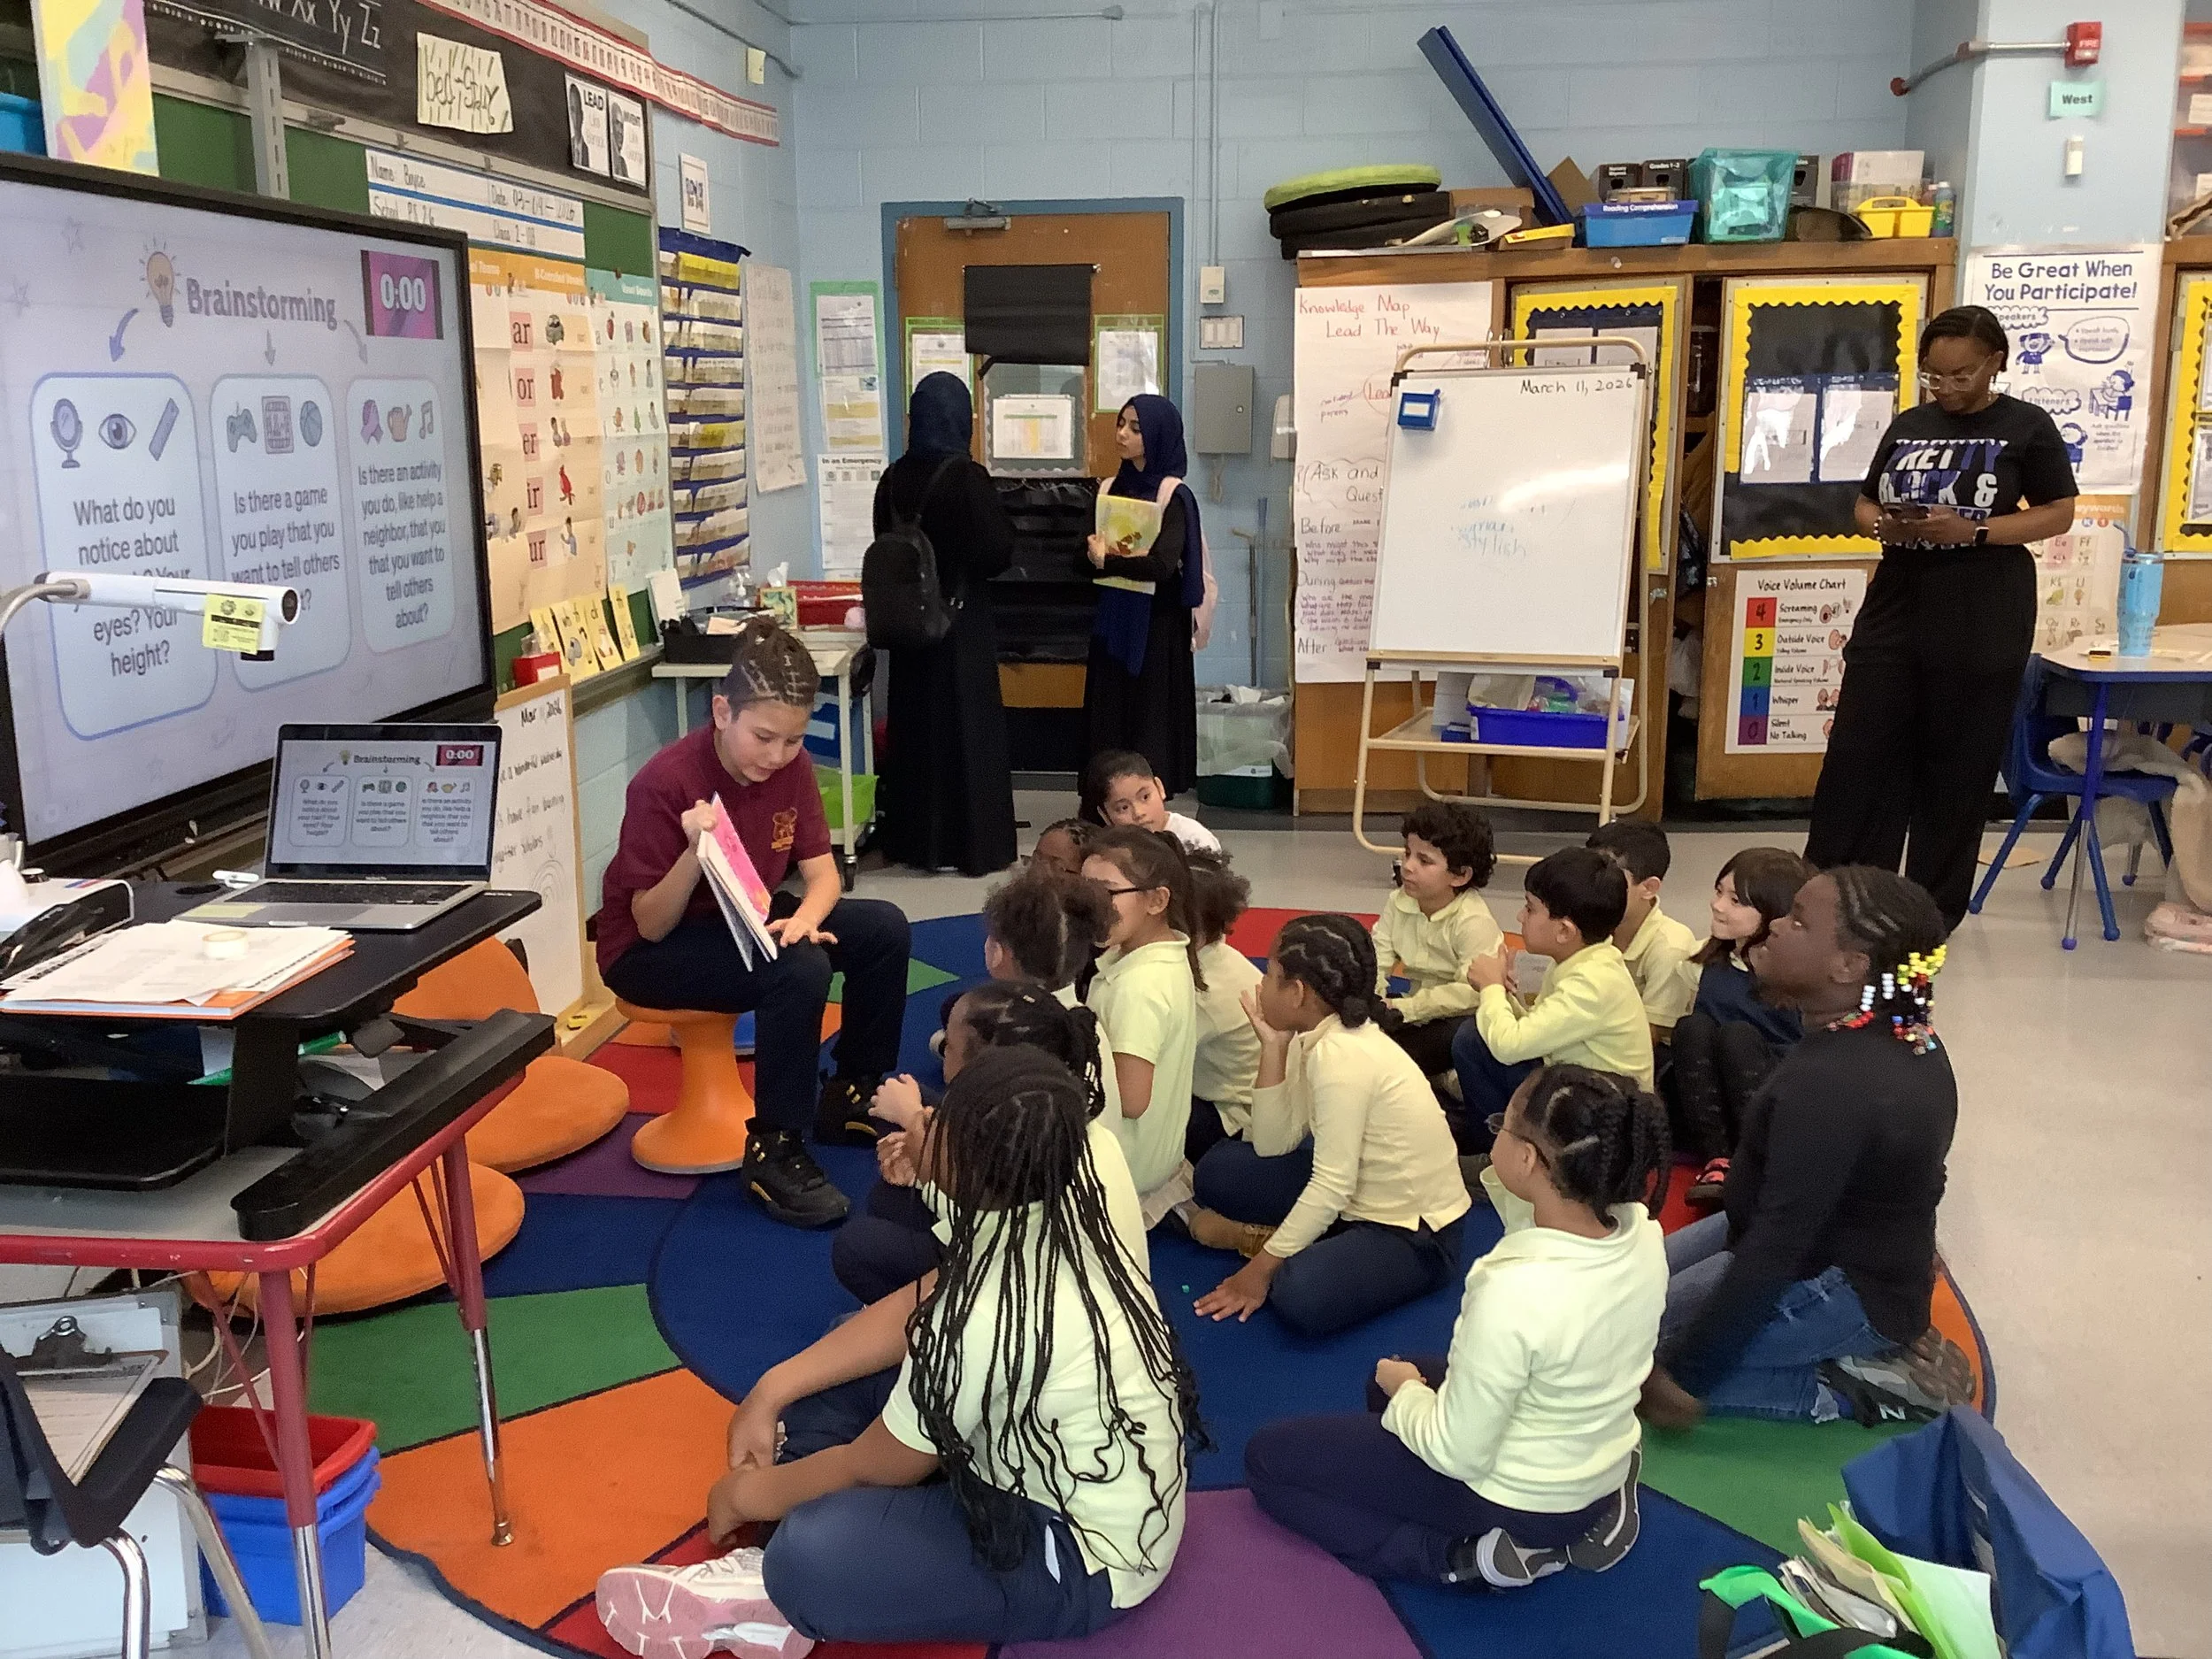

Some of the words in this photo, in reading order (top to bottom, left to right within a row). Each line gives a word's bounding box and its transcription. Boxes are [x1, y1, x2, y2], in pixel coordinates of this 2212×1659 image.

[583, 88, 603, 111] LEAD
[2062, 94, 2093, 104] West
[1991, 262, 2013, 280] Be
[2018, 260, 2079, 279] Great
[2085, 260, 2133, 277] When
[380, 273, 426, 312] 0:00
[1985, 283, 2015, 302] You
[2020, 281, 2138, 303] Participate!
[186, 278, 337, 331] Brainstorming
[1299, 295, 1365, 319] Knowledge
[1377, 294, 1410, 320] Map
[1995, 312, 2037, 321] peakers
[512, 320, 531, 344] ar
[1325, 320, 1362, 338] Lead
[1374, 318, 1398, 336] The
[1411, 317, 1440, 343] Way
[517, 376, 534, 400] or
[1520, 380, 1566, 395] March
[1594, 379, 1632, 393] 2026
[522, 431, 538, 454] er
[358, 465, 367, 485] Is
[369, 464, 395, 485] there
[397, 465, 408, 481] an
[410, 460, 442, 482] activity
[1310, 464, 1338, 480] Ask
[1347, 465, 1379, 480] and
[234, 491, 246, 514] Is
[249, 490, 281, 513] there
[285, 492, 293, 508] a
[295, 488, 327, 511] game
[526, 482, 540, 508] ir
[1878, 471, 1962, 505] BLACK
[1974, 472, 1998, 508] &
[73, 499, 119, 526] What
[123, 496, 144, 520] do
[148, 498, 175, 525] you
[362, 499, 380, 520] you
[398, 491, 414, 511] like
[416, 488, 435, 512] help
[437, 491, 443, 506] a
[364, 524, 409, 548] neighbor,
[410, 519, 428, 538] that
[429, 519, 446, 540] you
[1301, 517, 1340, 534] Before
[79, 537, 130, 565] notice
[134, 530, 180, 557] about
[232, 533, 257, 557] you
[259, 525, 285, 552] play
[288, 520, 312, 543] that
[313, 521, 335, 544] you
[529, 538, 545, 562] ur
[232, 565, 264, 583] want
[266, 561, 280, 581] to
[281, 556, 301, 580] tell
[303, 553, 341, 575] others
[368, 554, 389, 575] that
[391, 554, 410, 576] you
[411, 548, 434, 567] want
[434, 546, 445, 563] to
[386, 580, 402, 602] tell
[403, 576, 434, 599] others
[1758, 579, 1780, 591] Voice
[1784, 577, 1816, 590] Volume
[1819, 577, 1847, 589] Chart
[396, 603, 429, 629] about?
[1755, 602, 1766, 621] 4
[1779, 603, 1817, 615] Screaming
[94, 609, 141, 645] eyes?
[144, 608, 178, 630] Your
[1298, 637, 1327, 654] After
[1755, 633, 1763, 650] 3
[1777, 634, 1804, 644] Outside
[1806, 634, 1825, 644] Voice
[111, 640, 171, 677] height?
[1753, 662, 1761, 681] 2
[1775, 664, 1794, 673] Inside
[1796, 664, 1815, 673] Voice
[1753, 692, 1758, 711] 1
[1772, 695, 1799, 707] Whisper
[1747, 720, 1758, 740] 0
[1770, 718, 1790, 728] Silent
[1783, 730, 1807, 741] Talking
[354, 755, 420, 765] Brainstorming
[445, 749, 474, 759] 0:00
